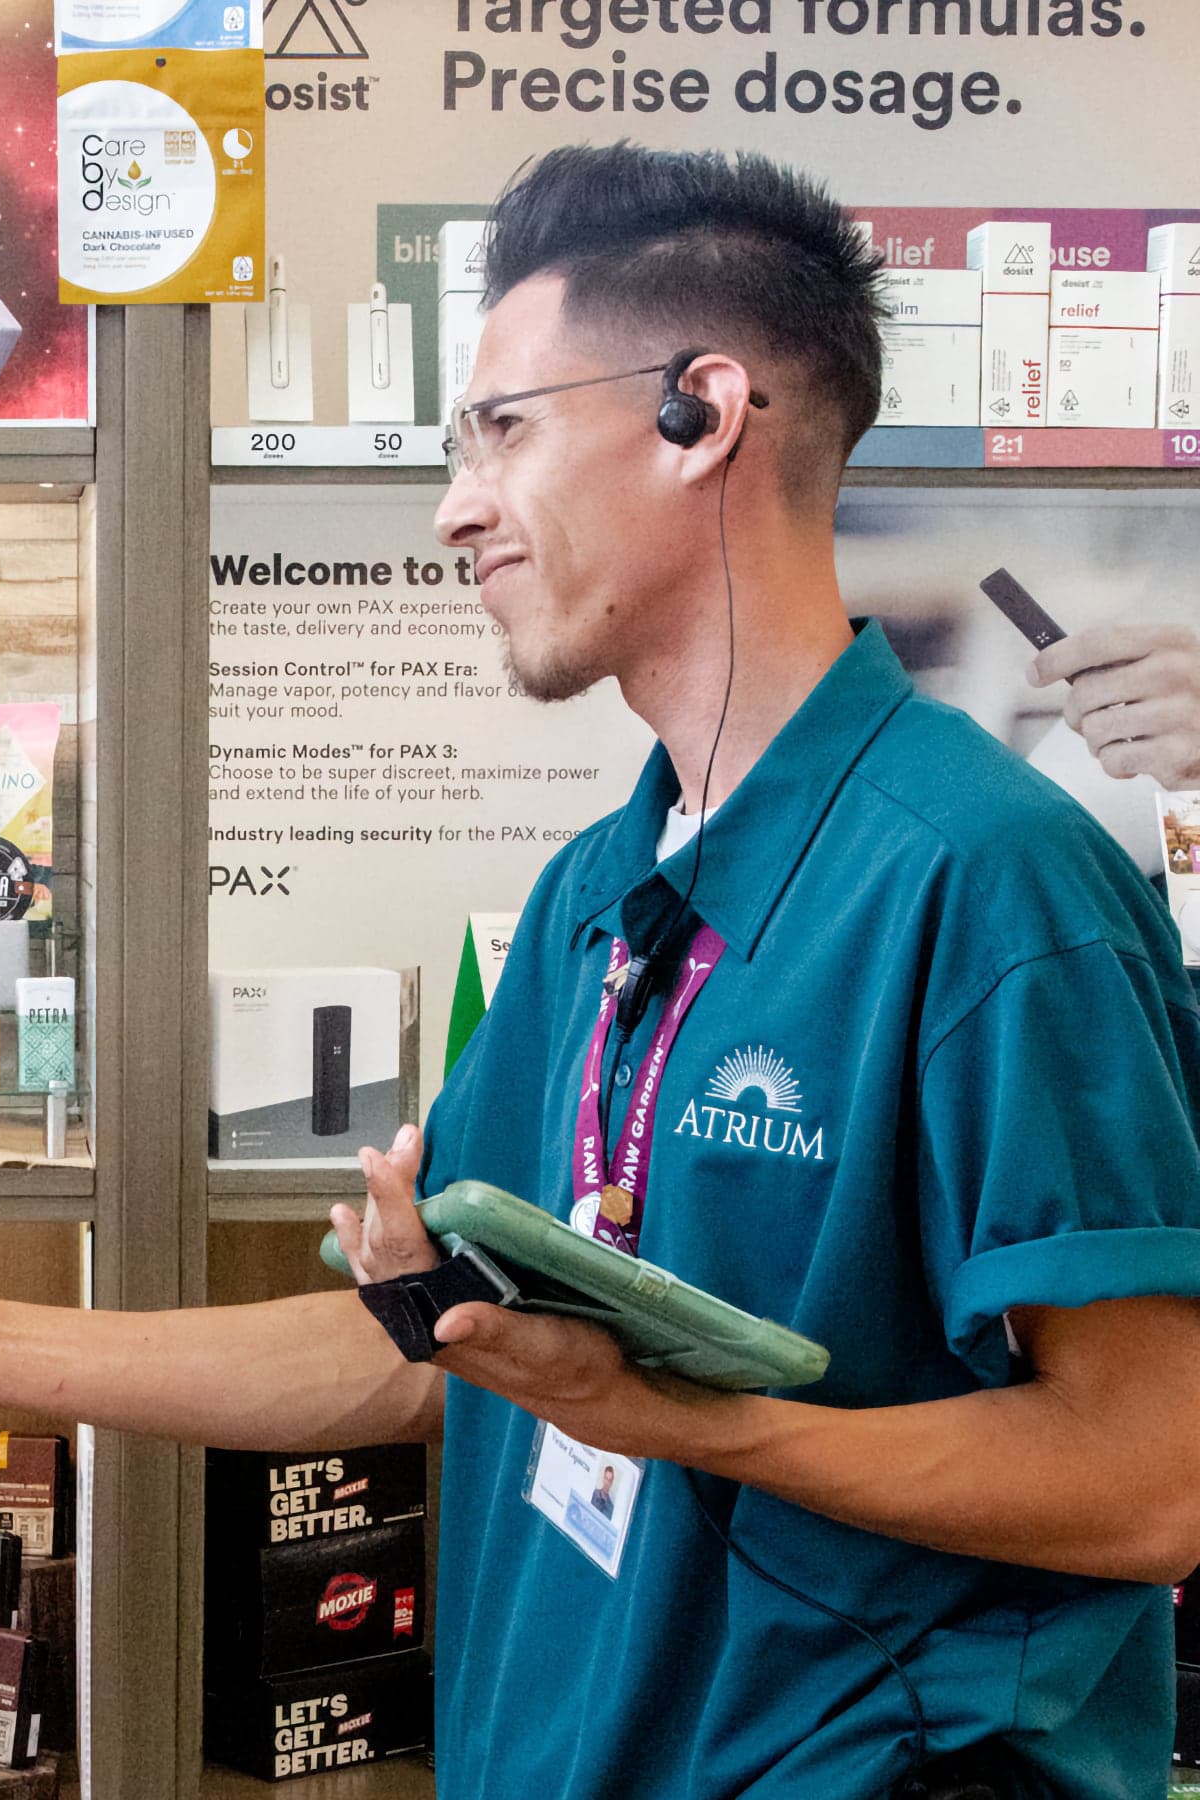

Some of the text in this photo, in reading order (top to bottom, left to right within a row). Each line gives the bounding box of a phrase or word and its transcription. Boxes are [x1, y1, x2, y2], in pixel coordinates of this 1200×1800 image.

[265, 71, 380, 111] osist™
[443, 50, 1022, 131] Precise dosage.
[82, 134, 146, 156] Care
[82, 154, 118, 190] by
[82, 181, 171, 216] design
[82, 229, 194, 240] CANNABIS-INFUSED
[82, 242, 161, 251] Dark Chocolate
[1002, 267, 1034, 276] dosist
[1060, 303, 1100, 318] relief
[1021, 359, 1041, 418] relief
[250, 433, 296, 451] 200
[374, 433, 402, 451] 50
[991, 435, 1023, 454] 2:1
[210, 553, 392, 586] Welcome
[403, 556, 444, 586] to
[210, 600, 266, 615] Create
[272, 602, 311, 618] your
[316, 602, 352, 615] own
[358, 600, 393, 615] PAX
[210, 621, 237, 636] the
[243, 622, 291, 638] taste,
[296, 621, 362, 640] delivery
[370, 621, 401, 636] and
[408, 623, 485, 639] economy
[209, 662, 278, 677] Session
[370, 662, 395, 677] for
[401, 662, 438, 677] PAX
[444, 662, 478, 677] Era:
[209, 683, 500, 702] Manage vapor, potency and flavor
[209, 703, 343, 721] suit your mood.
[209, 744, 286, 762] Dynamic
[369, 744, 395, 759] for
[400, 744, 437, 759] PAX
[442, 744, 458, 759] 3:
[209, 765, 600, 784] Choose to be super discreet, maximize power
[209, 785, 484, 803] and extend the life of your herb.
[209, 826, 283, 843] Industry
[289, 826, 354, 843] leading
[360, 826, 432, 843] security
[439, 826, 462, 841] for
[468, 826, 495, 841] the
[501, 826, 537, 841] PAX
[209, 866, 291, 896] PAX
[232, 987, 261, 999] PAX
[29, 1007, 68, 1024] PETRA
[618, 1047, 664, 1194] RAW GARDEN
[675, 1098, 825, 1160] ATRIUM
[583, 1135, 600, 1184] RAW
[269, 1458, 344, 1491] LET'S
[270, 1487, 321, 1517] GET
[270, 1505, 372, 1543] BETTER.
[319, 1585, 373, 1619] MOXIE
[275, 1694, 348, 1728] LET'S
[275, 1723, 325, 1752] GET
[275, 1738, 375, 1777] BETTER.
